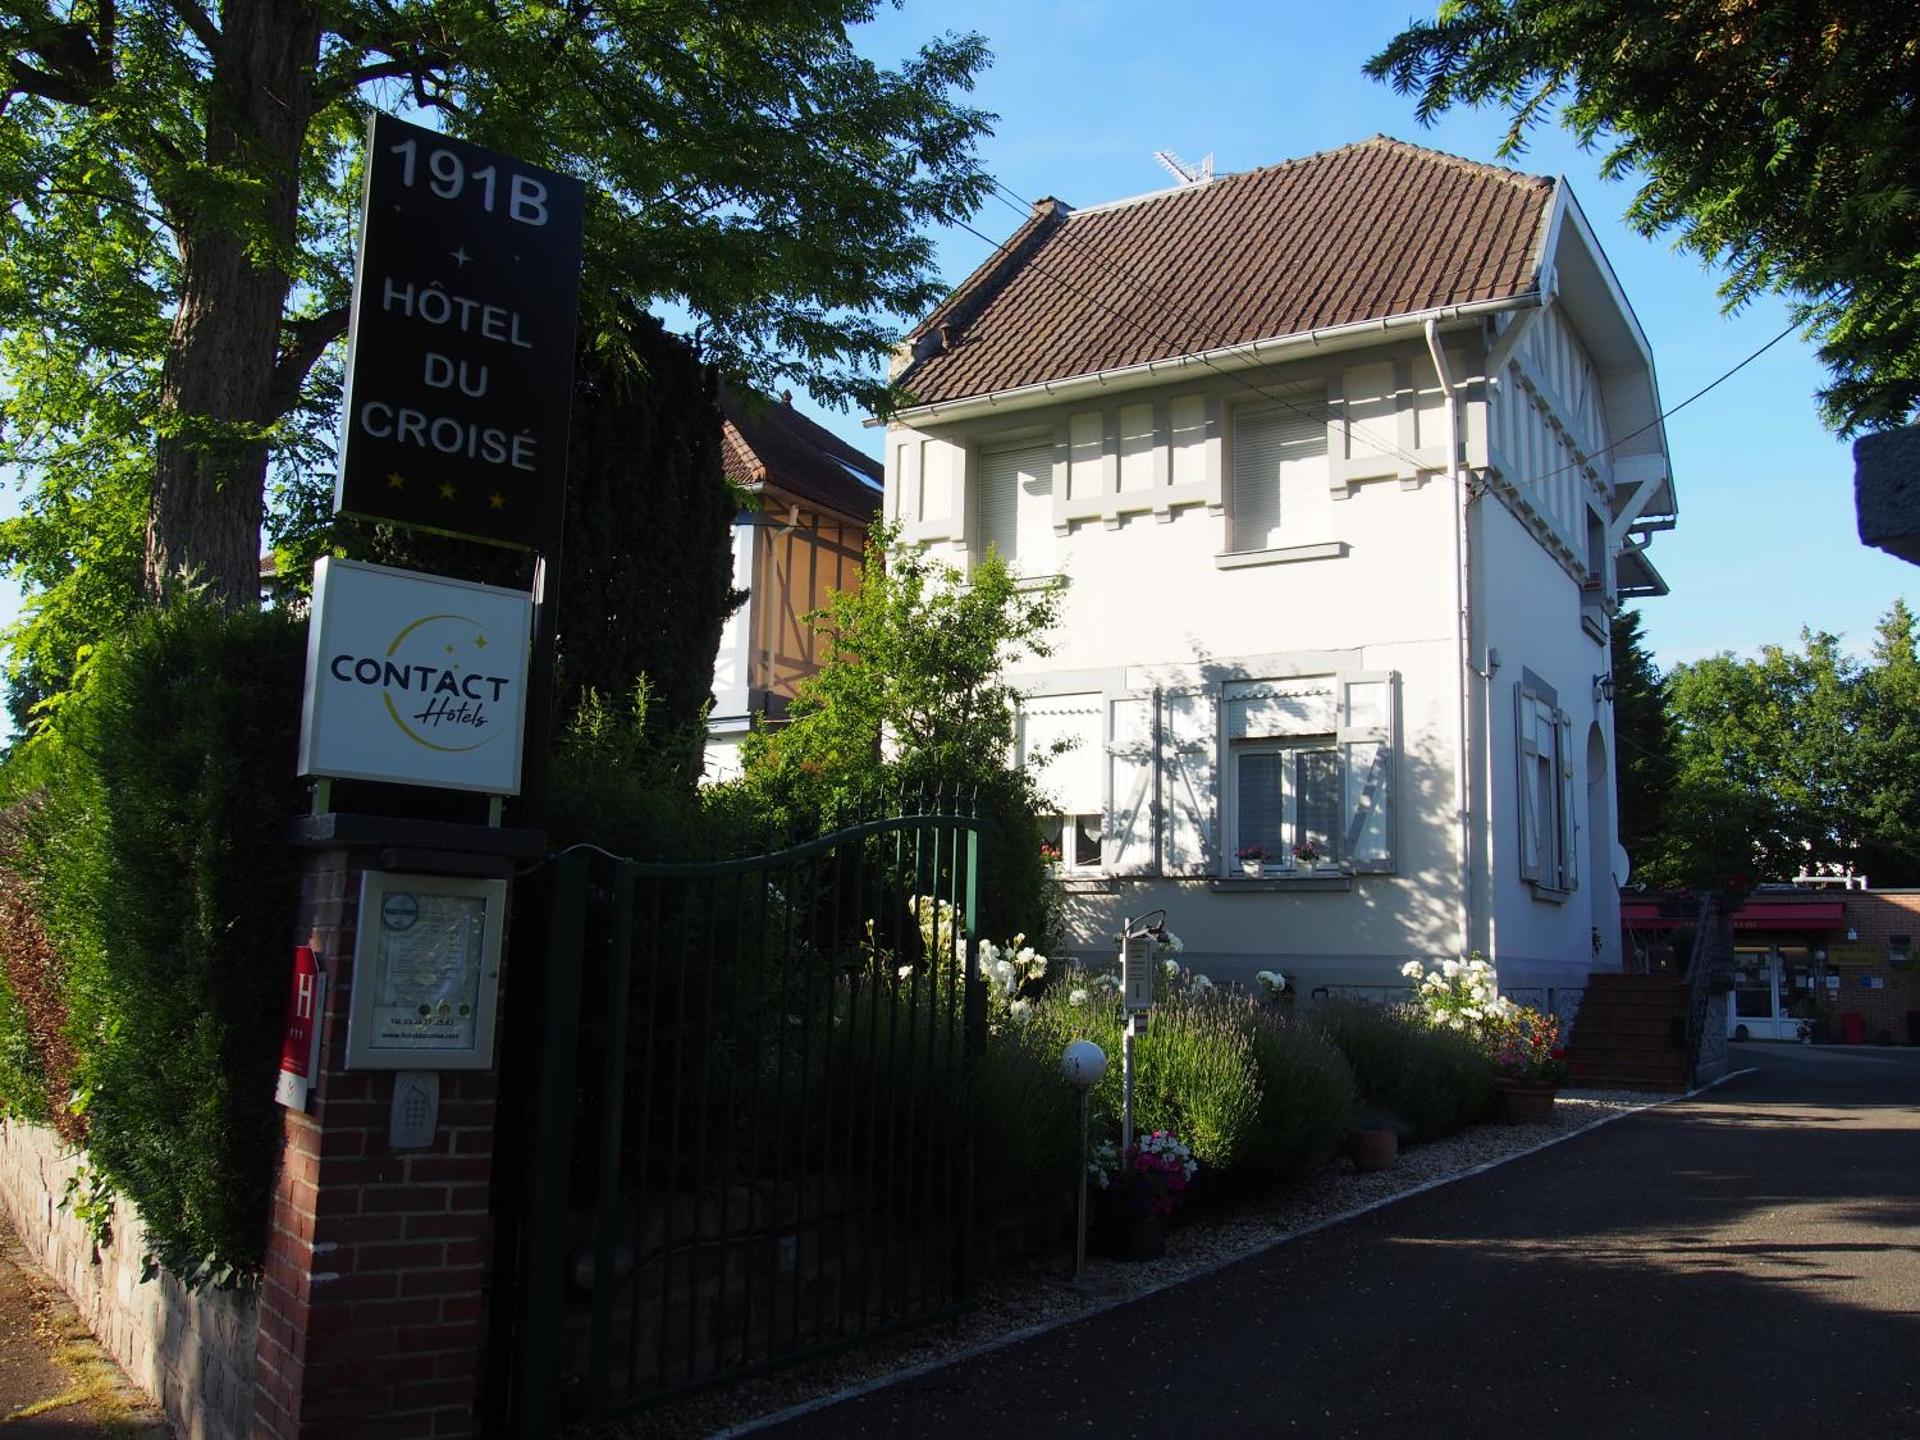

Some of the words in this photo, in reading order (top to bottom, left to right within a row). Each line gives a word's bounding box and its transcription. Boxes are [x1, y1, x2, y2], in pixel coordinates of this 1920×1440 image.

[390, 139, 549, 227] 191B
[382, 276, 533, 349] HÔTEL
[423, 352, 488, 398] DU
[360, 401, 537, 472] CROISÉ
[331, 654, 509, 702] CONTACT
[297, 973, 313, 1019] H
